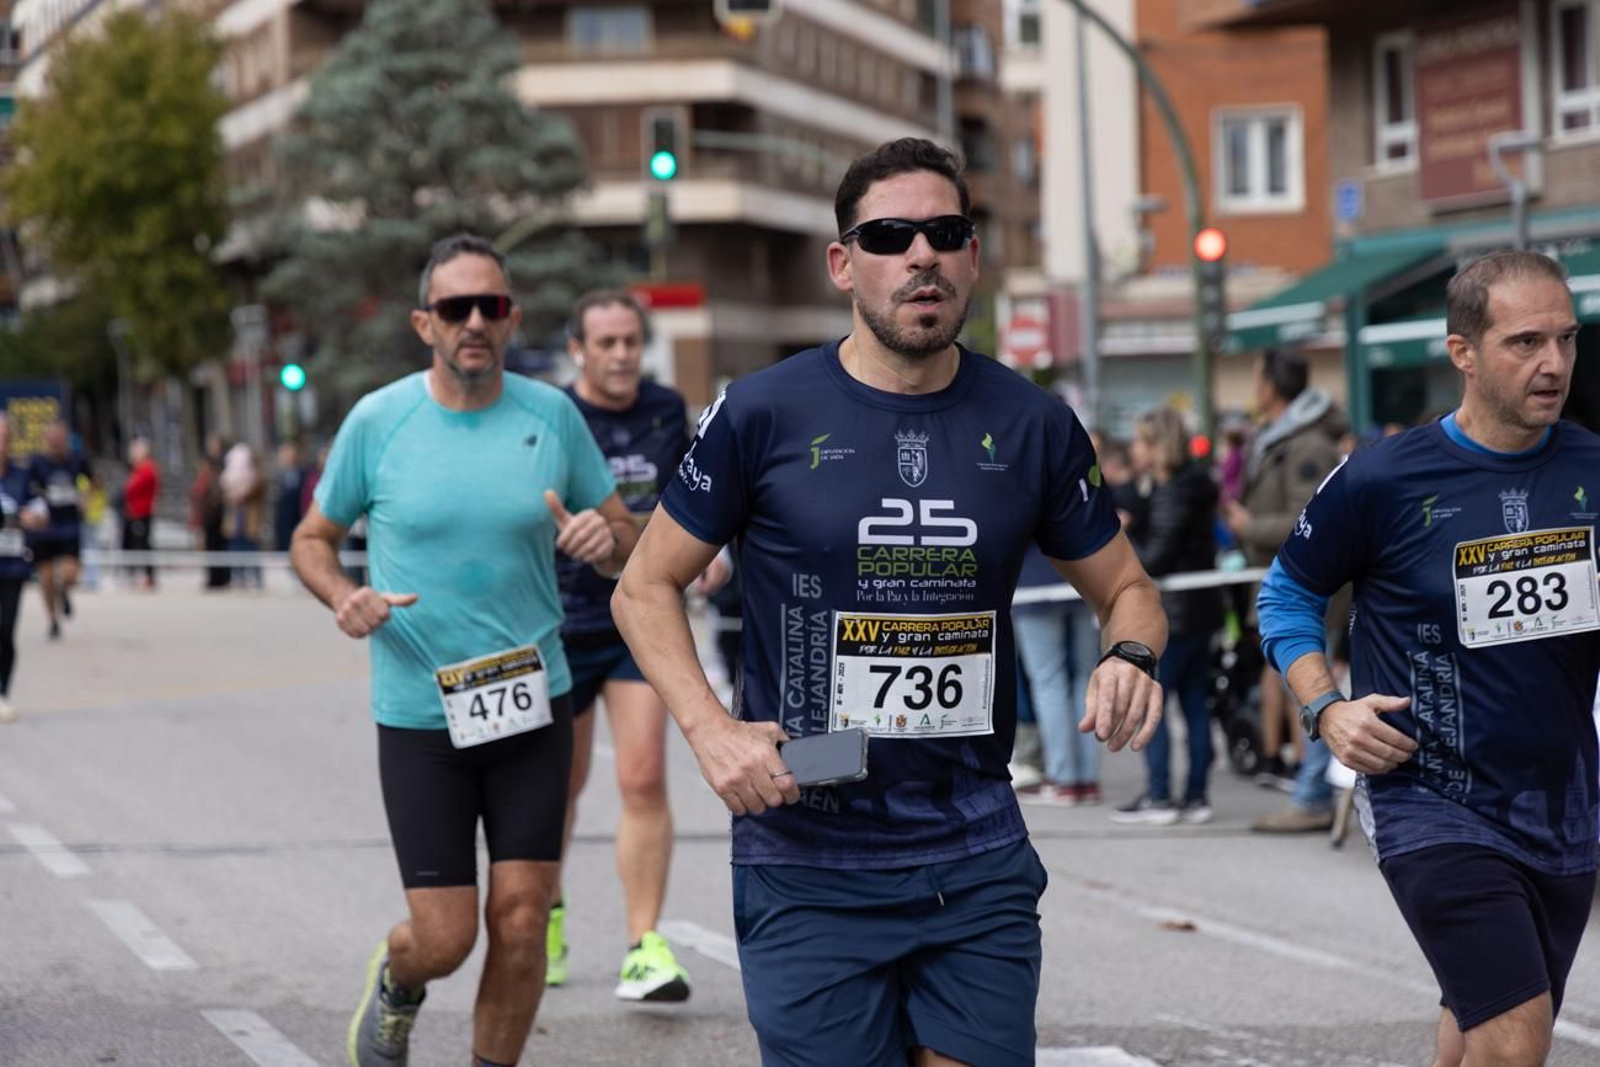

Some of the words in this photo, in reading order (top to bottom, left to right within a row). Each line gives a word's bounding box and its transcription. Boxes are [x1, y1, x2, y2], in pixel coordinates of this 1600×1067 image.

[858, 498, 977, 546] 25
[857, 546, 976, 561] CARRERA
[1458, 545, 1486, 566] XXV
[1487, 537, 1535, 552] CARRERA
[1536, 531, 1586, 545] POPULAR
[1488, 553, 1495, 562] y
[1501, 548, 1529, 559] gran
[1533, 539, 1586, 554] caminata
[857, 561, 978, 577] POPULAR
[792, 573, 822, 599] IES
[857, 590, 873, 601] Por
[875, 590, 885, 601] la
[887, 590, 902, 602] Paz
[911, 590, 920, 601] la
[858, 579, 868, 589] y
[872, 579, 906, 590] gran
[910, 578, 976, 588] caminata
[1486, 572, 1569, 619] 283
[842, 620, 880, 642] XXV
[882, 621, 940, 632] CARRERA
[941, 618, 990, 631] POPULAR
[882, 632, 890, 642] y
[898, 632, 931, 643] gran
[938, 628, 989, 641] caminata
[1417, 624, 1442, 644] IES
[787, 606, 805, 708] CATALINA
[808, 610, 828, 733] LEJANDRÍA
[869, 664, 963, 711] 736
[469, 682, 532, 721] 476
